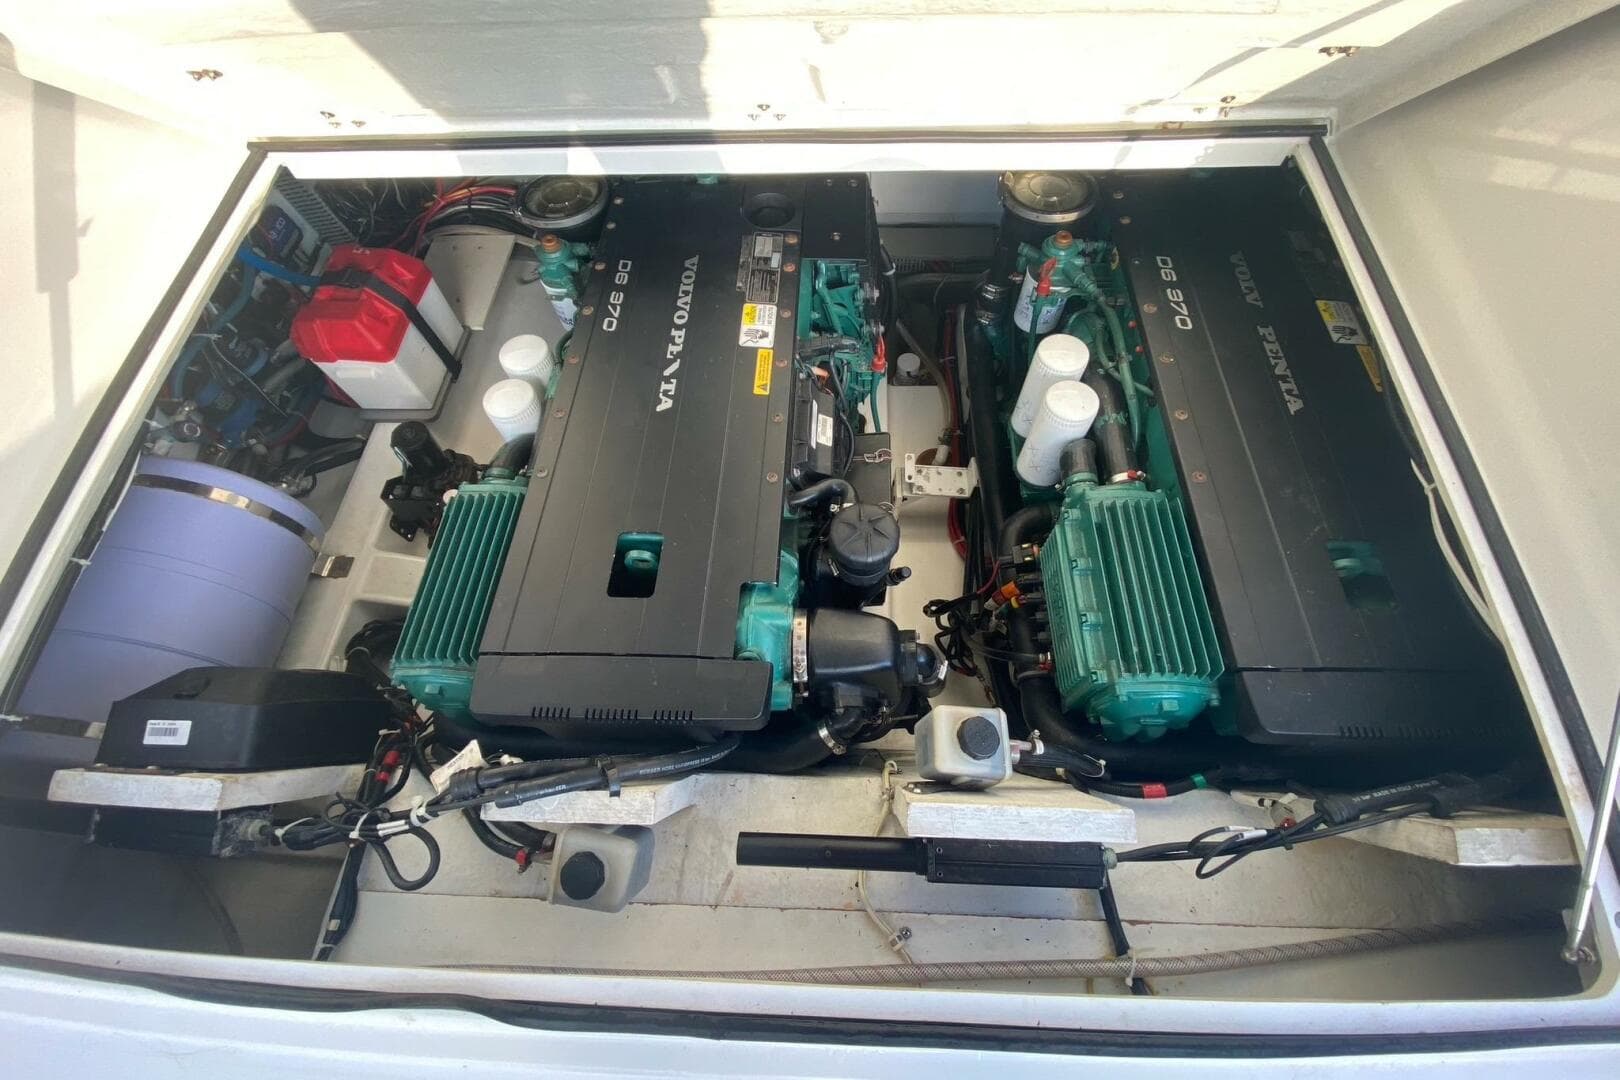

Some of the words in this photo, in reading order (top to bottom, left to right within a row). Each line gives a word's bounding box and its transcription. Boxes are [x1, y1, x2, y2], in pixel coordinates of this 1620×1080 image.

[614, 259, 633, 285] D6
[673, 254, 700, 325] VOLVO
[1156, 255, 1177, 282] D6
[602, 291, 625, 332] 370
[1166, 287, 1193, 330] 370
[1257, 325, 1305, 416] PENTA
